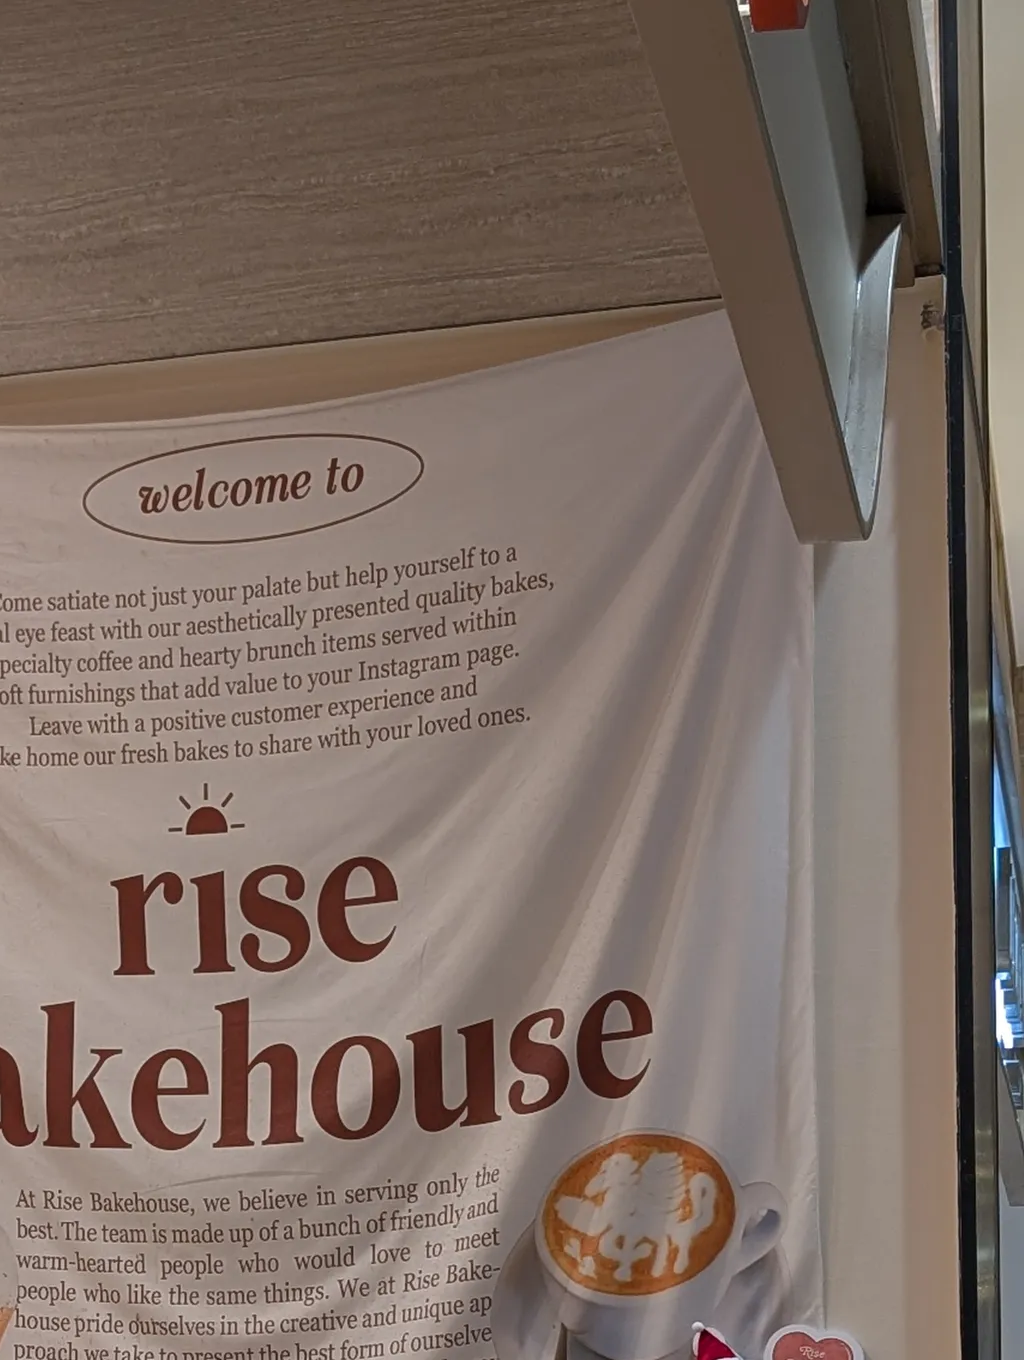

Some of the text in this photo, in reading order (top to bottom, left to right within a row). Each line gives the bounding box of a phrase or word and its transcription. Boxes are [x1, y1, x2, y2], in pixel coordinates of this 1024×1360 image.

[138, 457, 365, 515] welcome to
[16, 628, 45, 648] eye
[51, 621, 95, 642] feast
[100, 618, 142, 639] with
[148, 622, 181, 638] our
[187, 604, 307, 635] aesthetically
[312, 589, 409, 629] presented
[416, 581, 486, 614] quality
[490, 571, 554, 597] bakes,
[48, 590, 109, 611] satiate
[116, 590, 146, 608] not
[150, 586, 187, 612] just
[192, 586, 237, 609] your
[242, 576, 301, 605] palate
[307, 571, 339, 592] but
[346, 562, 388, 589] help
[394, 547, 476, 585] yourself
[480, 548, 500, 566] to
[506, 547, 517, 562] a
[77, 650, 133, 672] coffee
[139, 648, 173, 669] and
[180, 646, 241, 669] hearty
[246, 635, 316, 662] brunch
[322, 633, 376, 654] items
[382, 616, 447, 645] served
[452, 606, 516, 634] within
[28, 682, 135, 707] furnishings
[140, 680, 179, 701] that
[185, 676, 220, 698] add
[225, 673, 277, 695] value
[283, 672, 302, 690] to
[307, 668, 352, 693] your
[359, 652, 460, 681] Instagram
[467, 644, 519, 671] page.
[29, 675, 477, 737] Leave with a positive customer experience and
[27, 746, 79, 766] home
[84, 751, 116, 765] our
[121, 742, 168, 764] fresh
[174, 740, 228, 762] bakes
[234, 740, 253, 757] to
[259, 734, 312, 755] share
[317, 724, 361, 748] with
[366, 724, 412, 749] your
[418, 708, 472, 736] loved
[478, 708, 530, 727] ones.
[109, 855, 399, 976] rise
[16, 1166, 499, 1216] At Rise Bakehouse, we believe in serving only the
[16, 1192, 499, 1248] best. The team is made up of a bunch of friendly and
[799, 1346, 826, 1360] Rise
